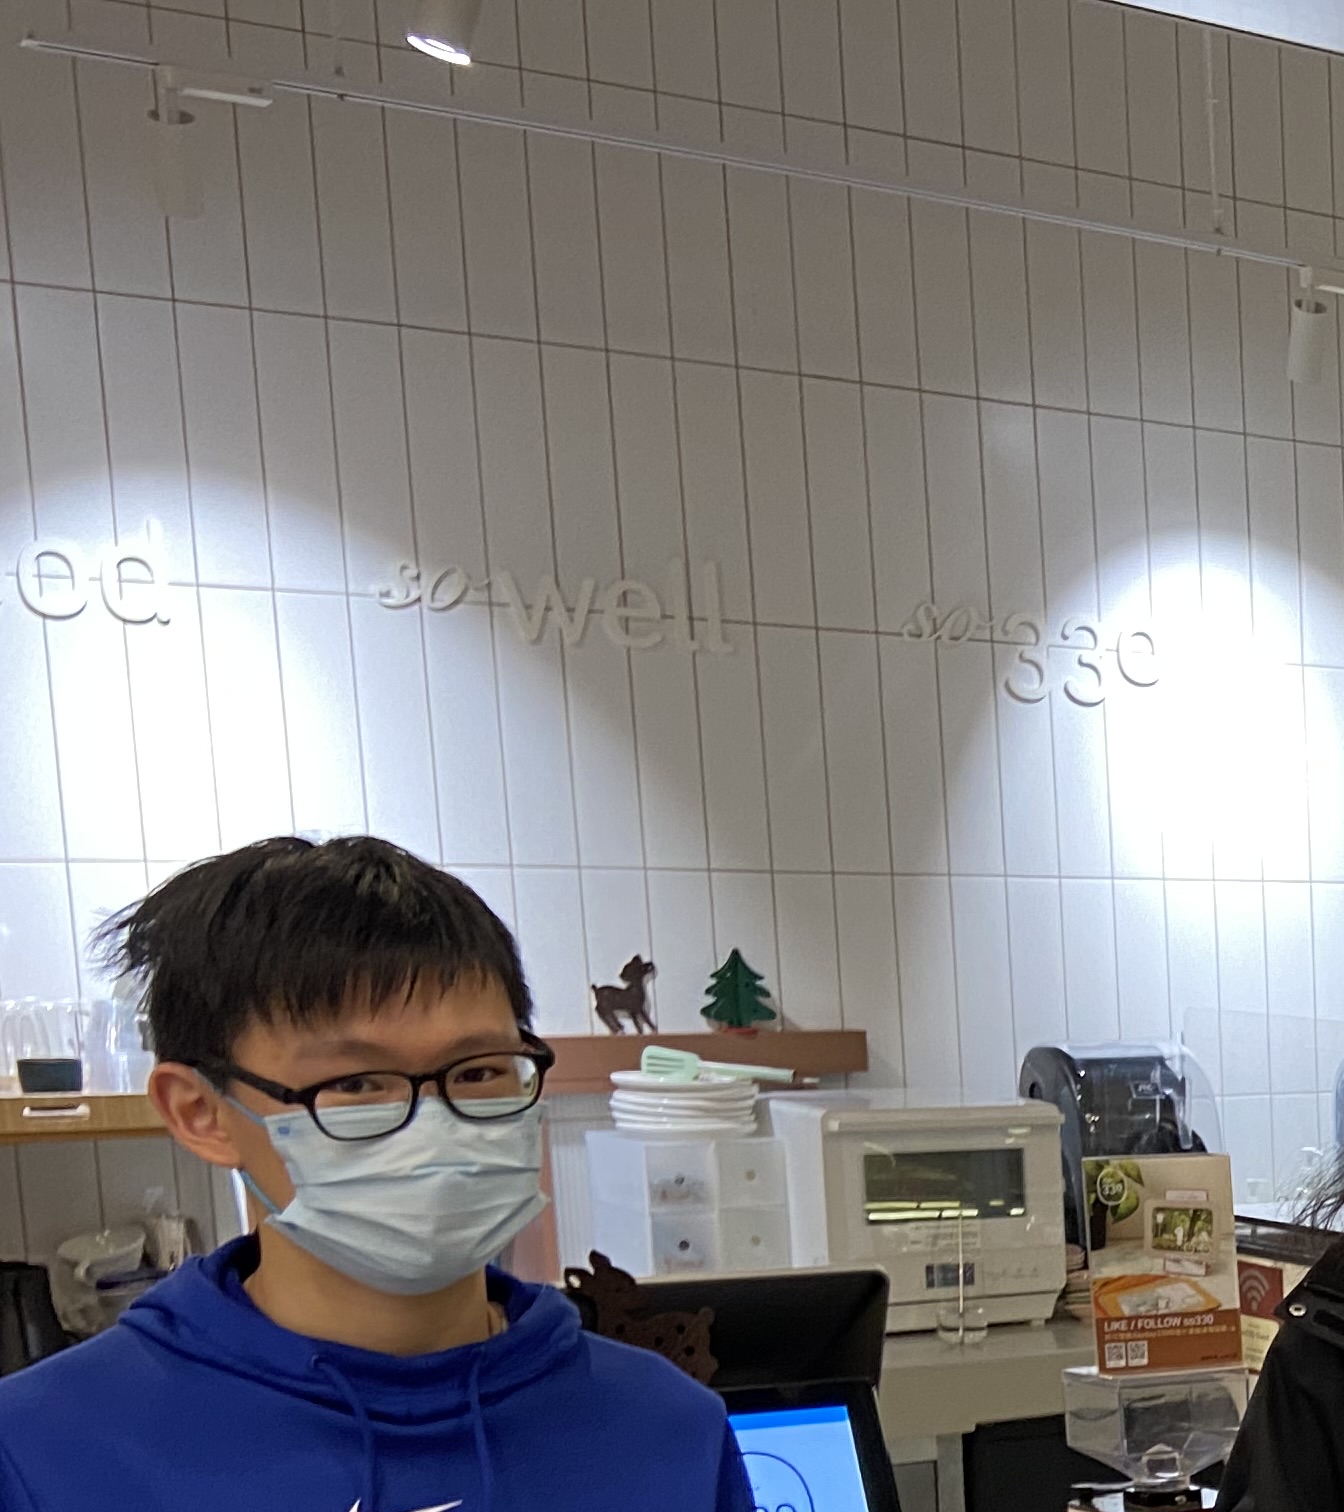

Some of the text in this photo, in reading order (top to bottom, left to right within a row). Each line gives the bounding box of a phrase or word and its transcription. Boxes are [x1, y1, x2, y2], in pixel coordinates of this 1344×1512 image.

[376, 554, 733, 655] so well
[900, 601, 994, 644] so
[1104, 1320, 1128, 1333] LIKE
[1137, 1316, 1182, 1330] FOLLOW
